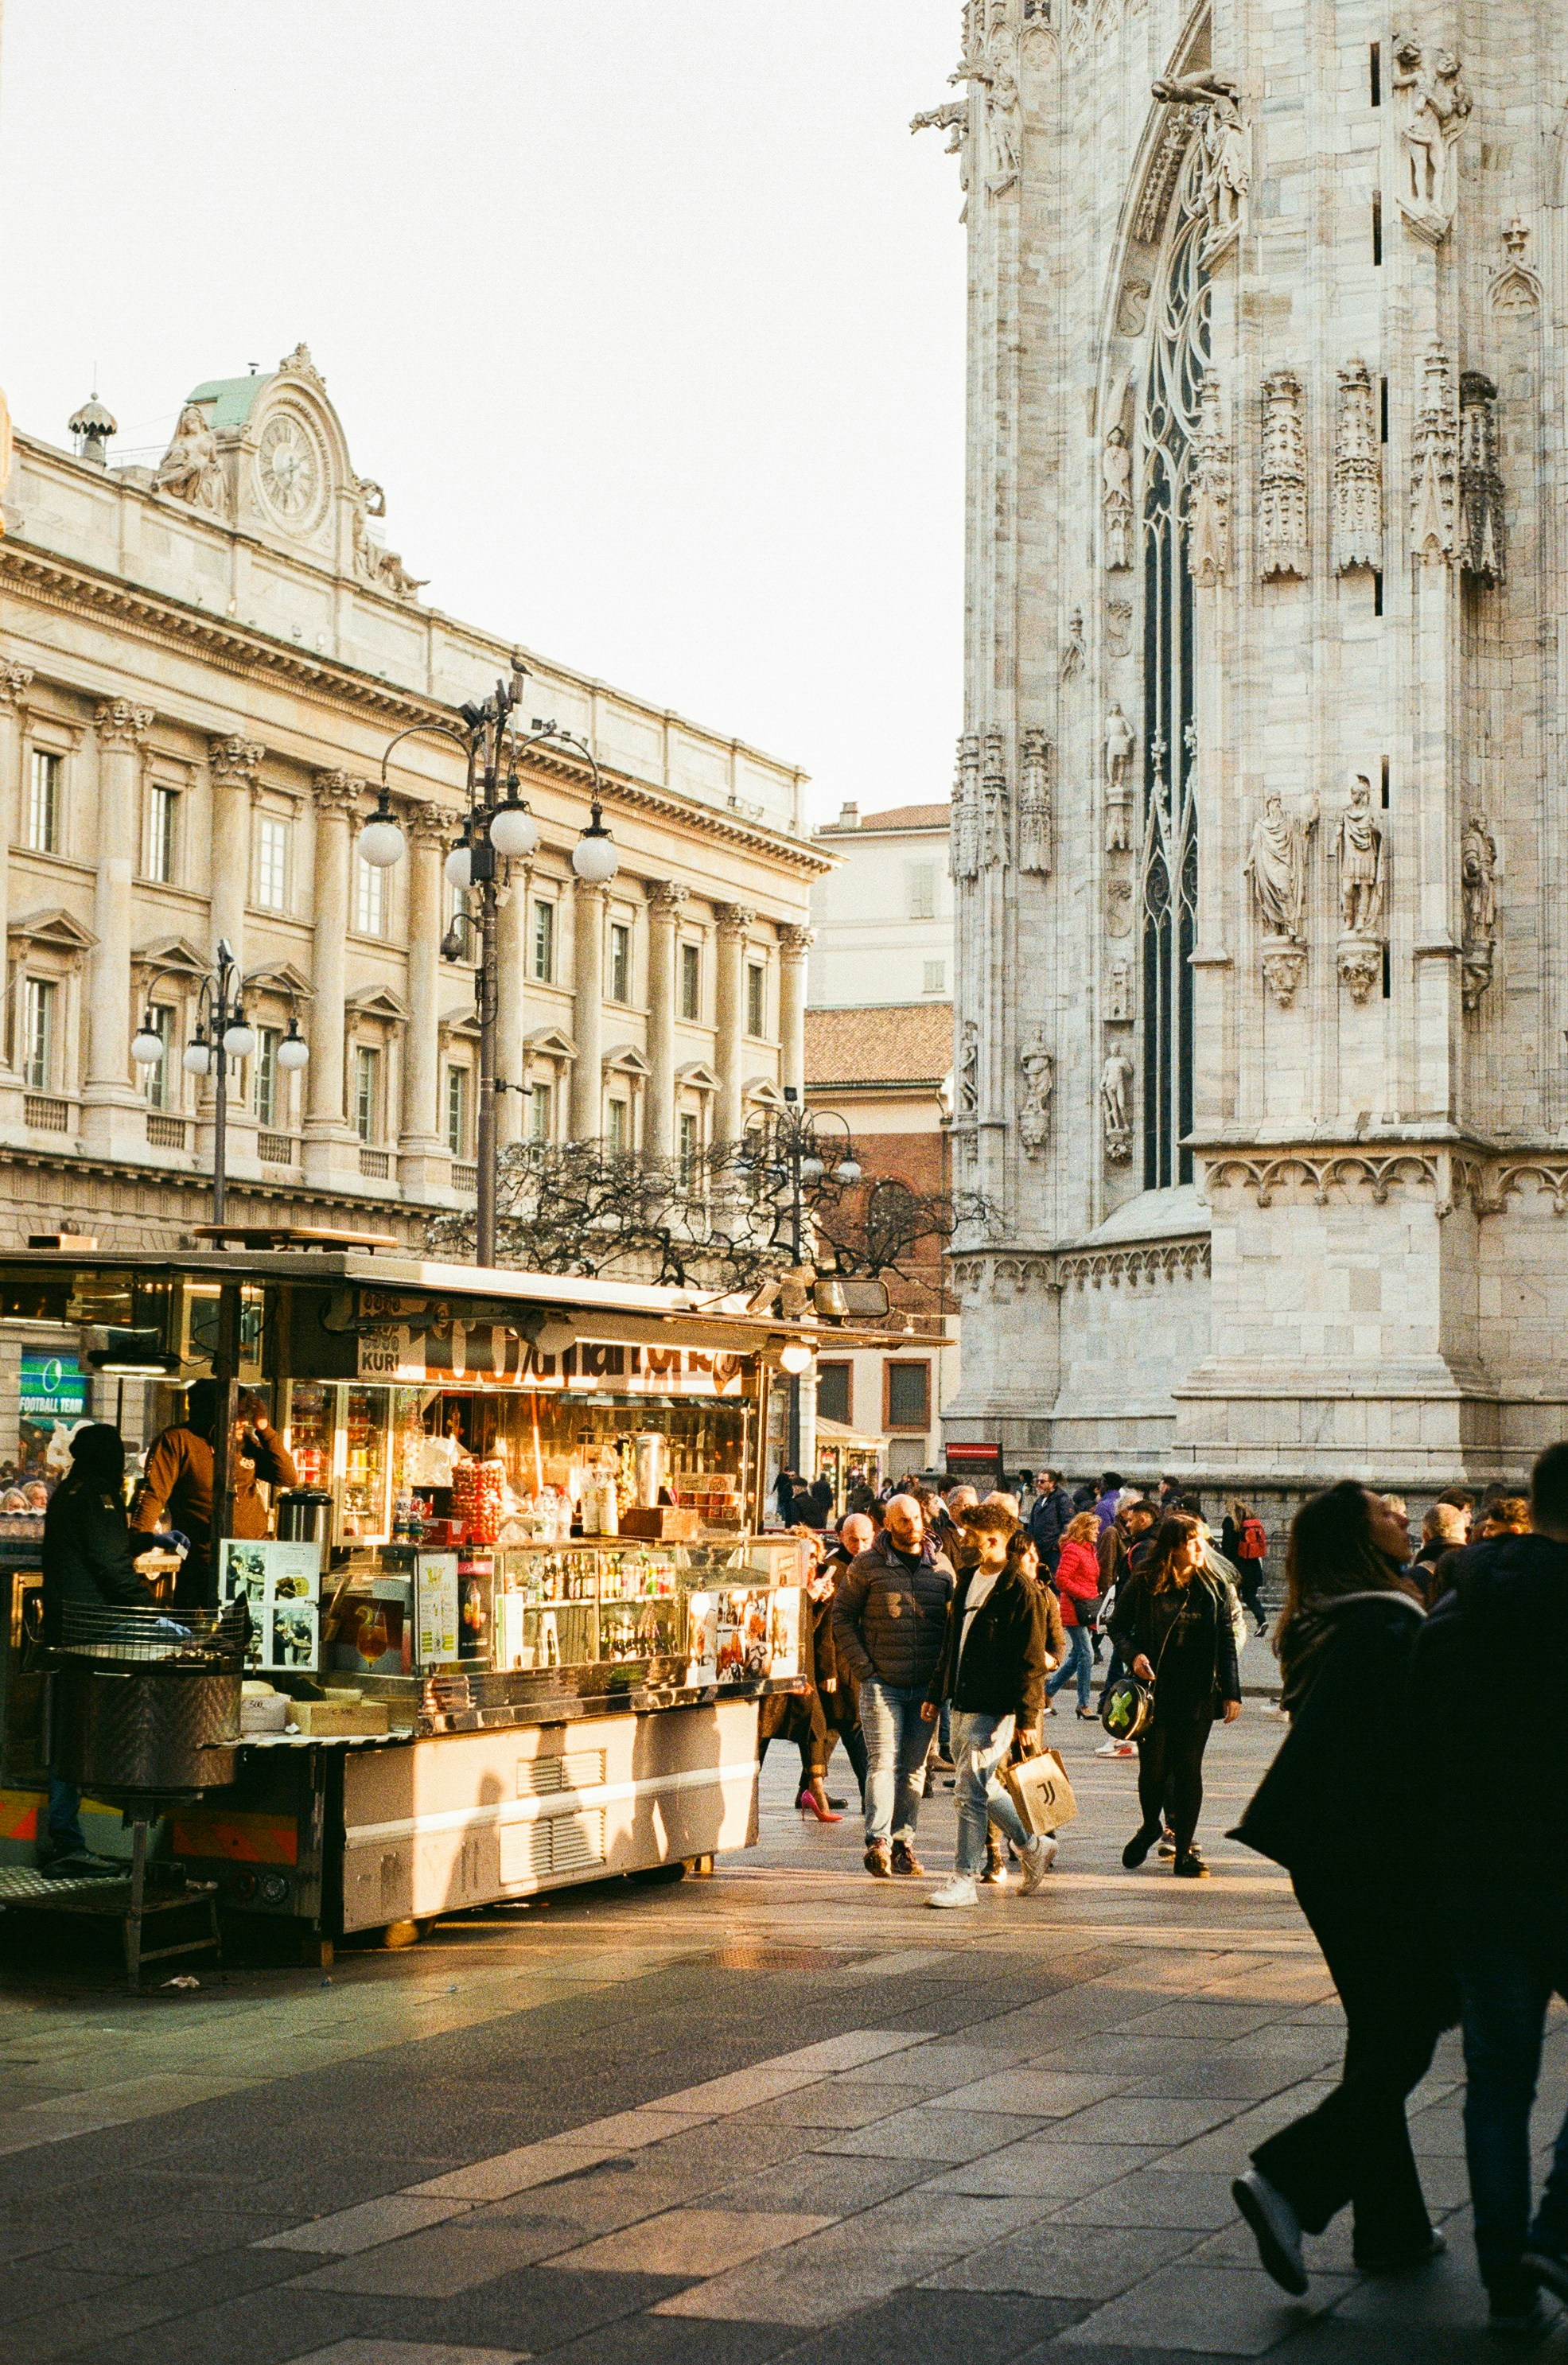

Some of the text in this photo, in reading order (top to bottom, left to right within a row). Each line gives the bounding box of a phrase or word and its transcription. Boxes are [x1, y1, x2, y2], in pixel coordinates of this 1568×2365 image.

[362, 1352, 399, 1371] KURI
[20, 1396, 83, 1414] FOOTBALL TEAM
